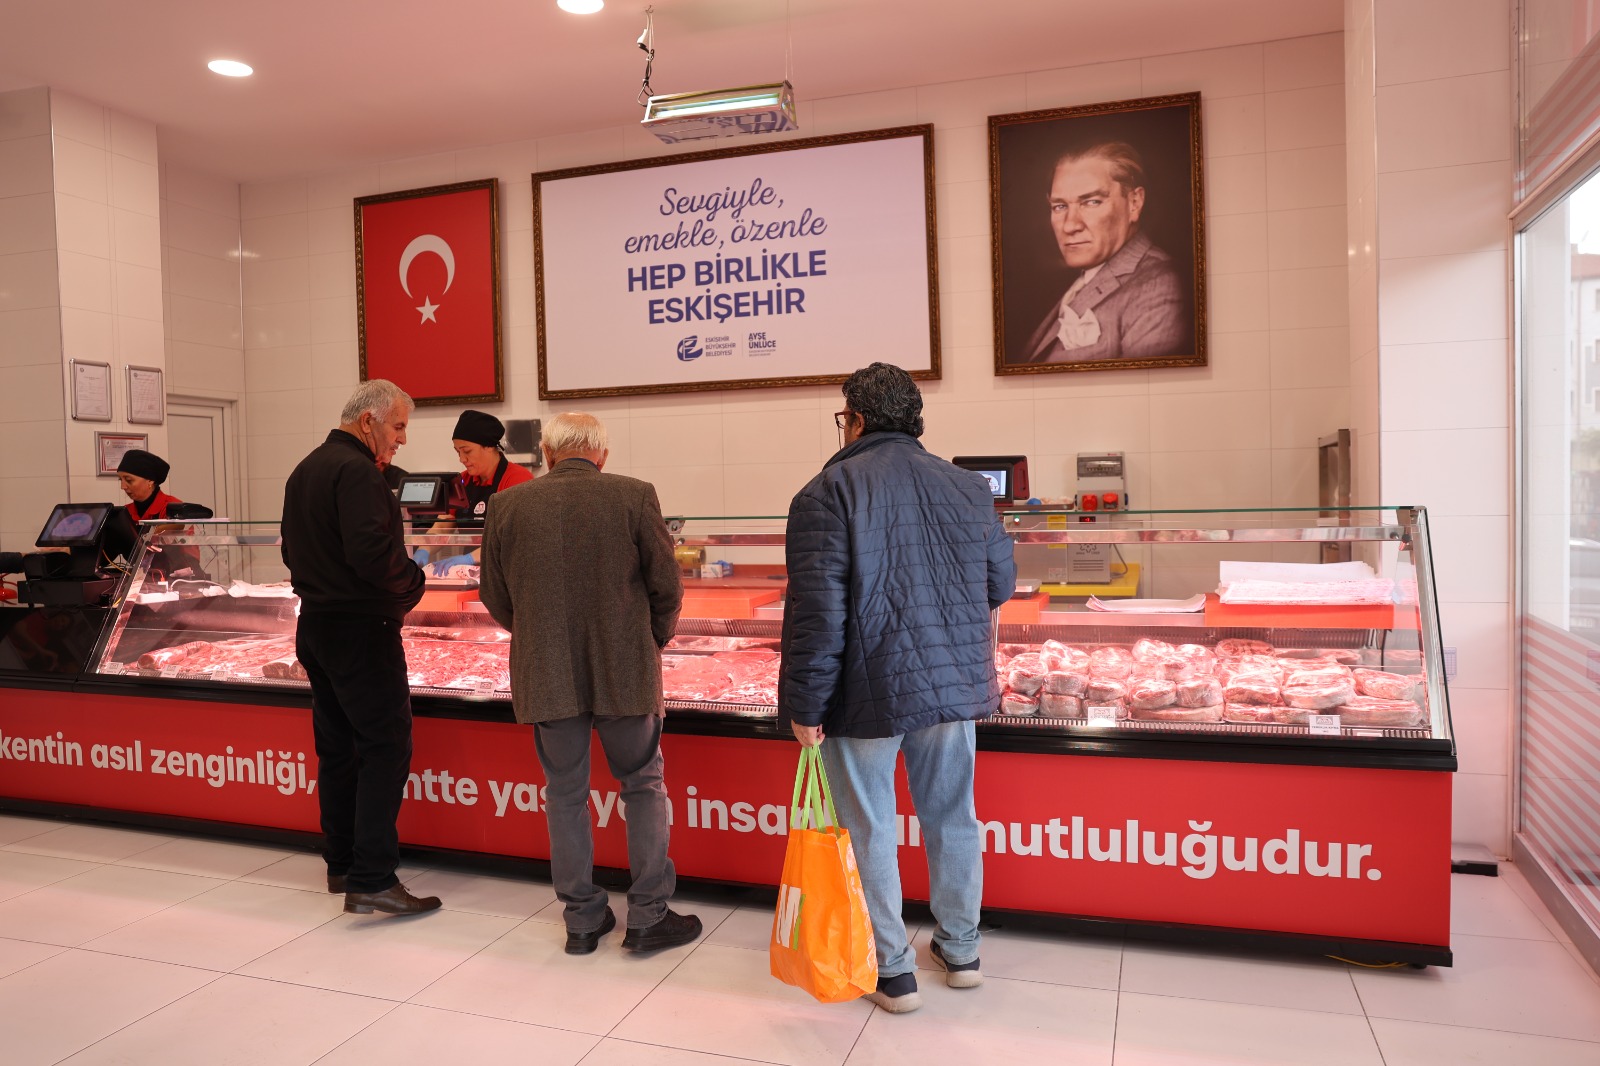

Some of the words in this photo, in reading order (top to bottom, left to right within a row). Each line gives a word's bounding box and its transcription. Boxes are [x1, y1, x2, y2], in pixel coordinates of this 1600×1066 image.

[660, 177, 784, 222] Sevgiyle,
[624, 219, 725, 254] emekle,
[730, 207, 828, 244] özenle
[627, 263, 686, 292] HEP
[694, 248, 827, 286] BİRLİKLE
[649, 282, 805, 324] ESKİŞEHİR
[748, 332, 766, 341] AYŞE
[748, 340, 776, 349] ÜNLÜCE
[0, 728, 83, 766] kentin
[91, 740, 143, 772] asıl
[150, 745, 317, 796] zenginliği,
[975, 815, 1382, 881] mutluluğudur.
